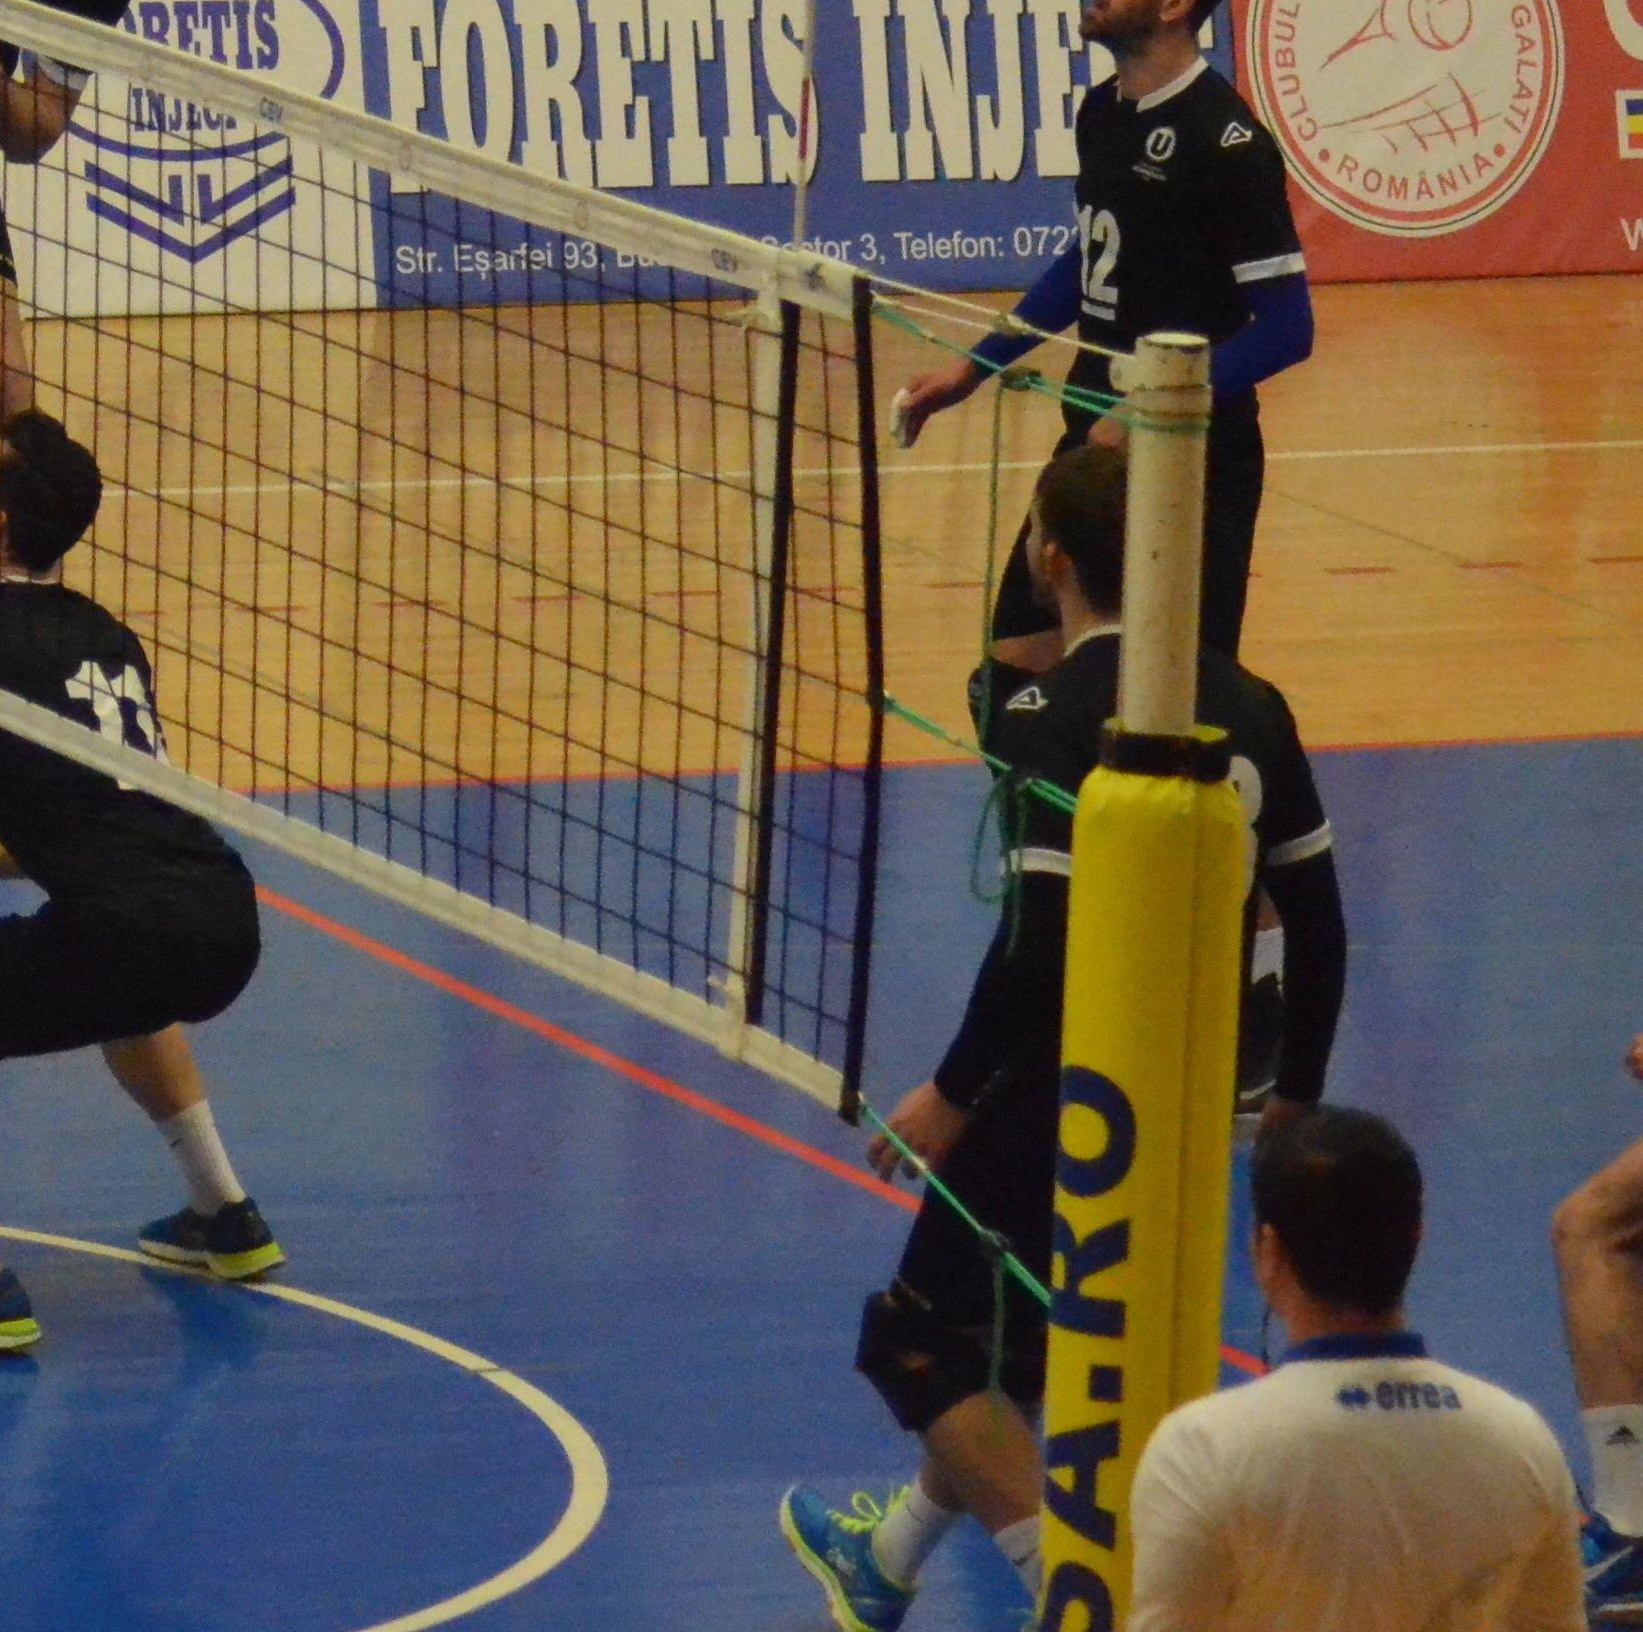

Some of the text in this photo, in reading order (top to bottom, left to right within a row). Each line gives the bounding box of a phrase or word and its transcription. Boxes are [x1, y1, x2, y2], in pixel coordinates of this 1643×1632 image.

[1273, 2, 1319, 143] CLUBUL
[1503, 3, 1539, 136] GALATI
[1336, 151, 1496, 201] ROMÂNIA
[394, 244, 444, 275] Str.
[893, 229, 1005, 261] Telefon:
[1073, 200, 1121, 305] 12
[1375, 1379, 1463, 1411] errea
